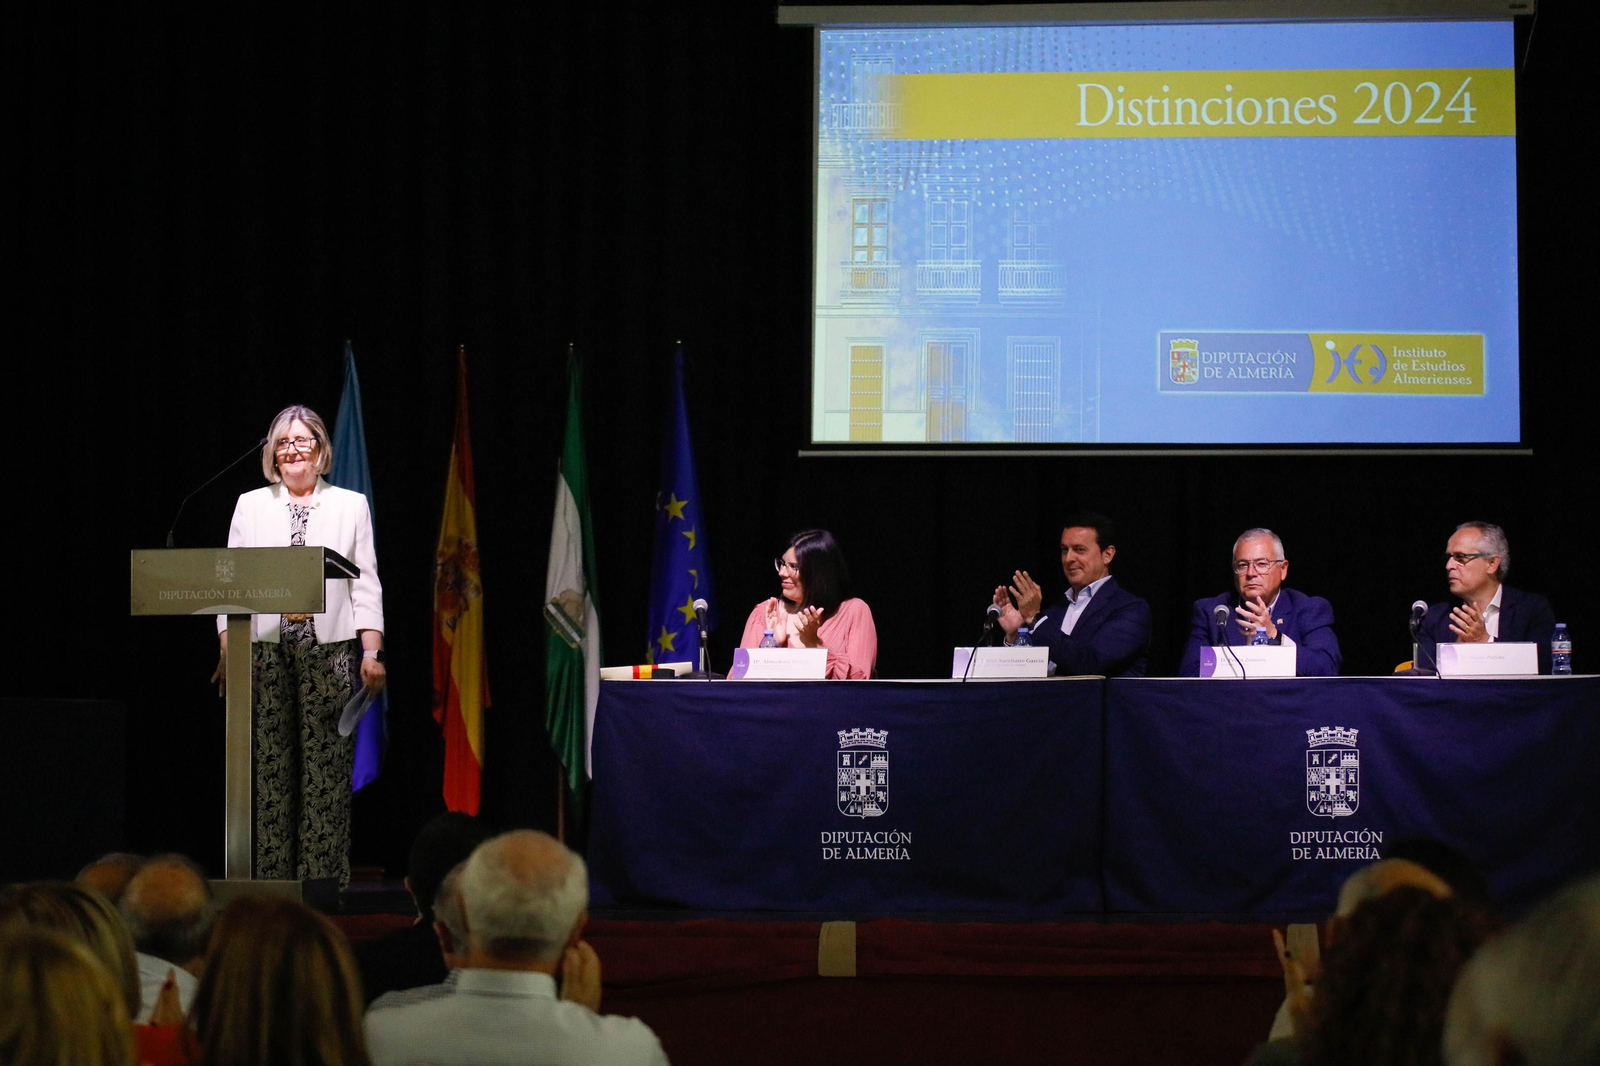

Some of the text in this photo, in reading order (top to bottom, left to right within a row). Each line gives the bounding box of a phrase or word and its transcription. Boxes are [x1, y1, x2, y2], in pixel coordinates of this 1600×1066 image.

[1075, 76, 1478, 127] Distinciones 2024
[1201, 349, 1297, 365] DIPUTACIÓN
[1392, 346, 1447, 358] Instituto
[1203, 364, 1295, 380] DE ALMERÍA
[1392, 359, 1466, 372] de Estudios
[1393, 373, 1473, 386] Almerienses
[159, 587, 293, 600] DIPUTACIÓN DE ALMERÍA
[820, 828, 912, 844] DIPUTACIÓN
[1289, 827, 1384, 844] DIPUTACIÓN
[822, 845, 911, 860] DE ALMERÍA
[1292, 844, 1381, 860] DE ALMERÍA
